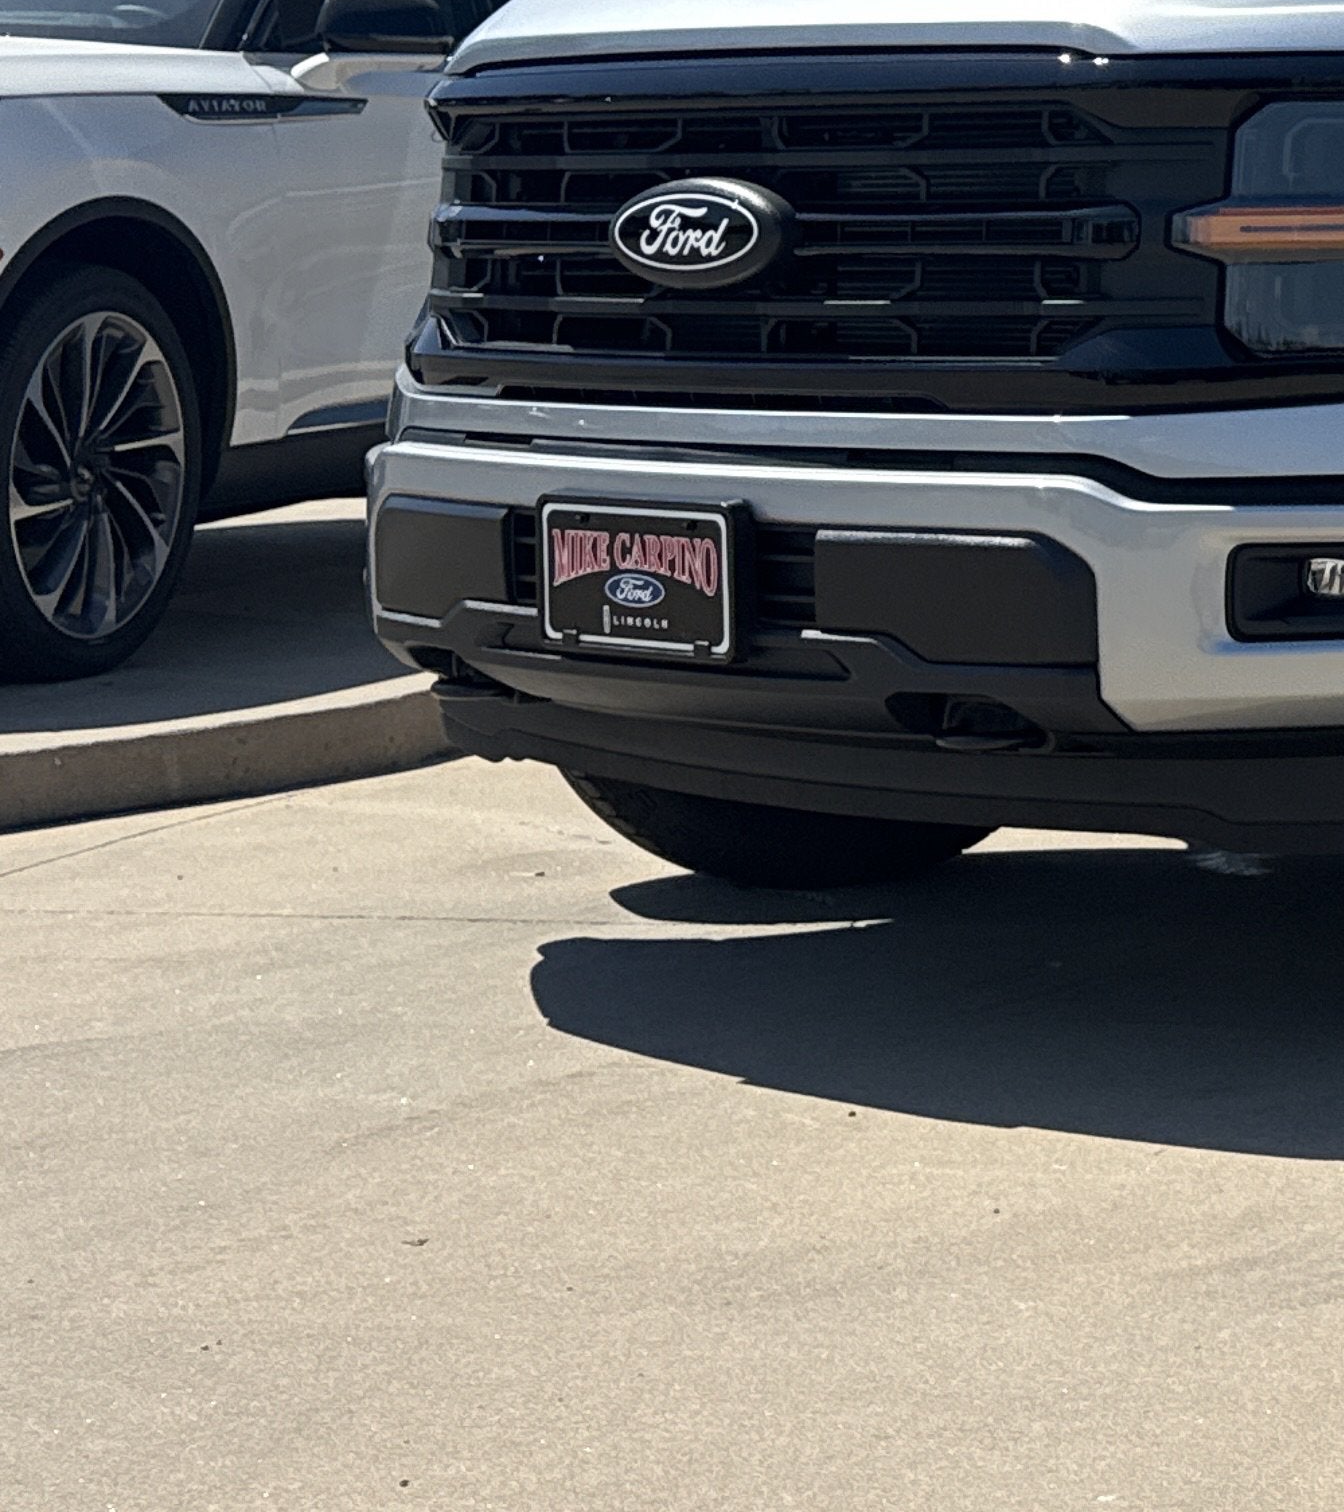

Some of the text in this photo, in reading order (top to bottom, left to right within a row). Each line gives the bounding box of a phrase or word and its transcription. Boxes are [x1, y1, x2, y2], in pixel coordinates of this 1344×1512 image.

[187, 99, 268, 113] AVIATOR
[639, 203, 730, 257] Ford
[552, 528, 719, 597] MIKE CARPINO
[616, 578, 654, 602] Ford
[612, 615, 669, 629] LINCOLN
